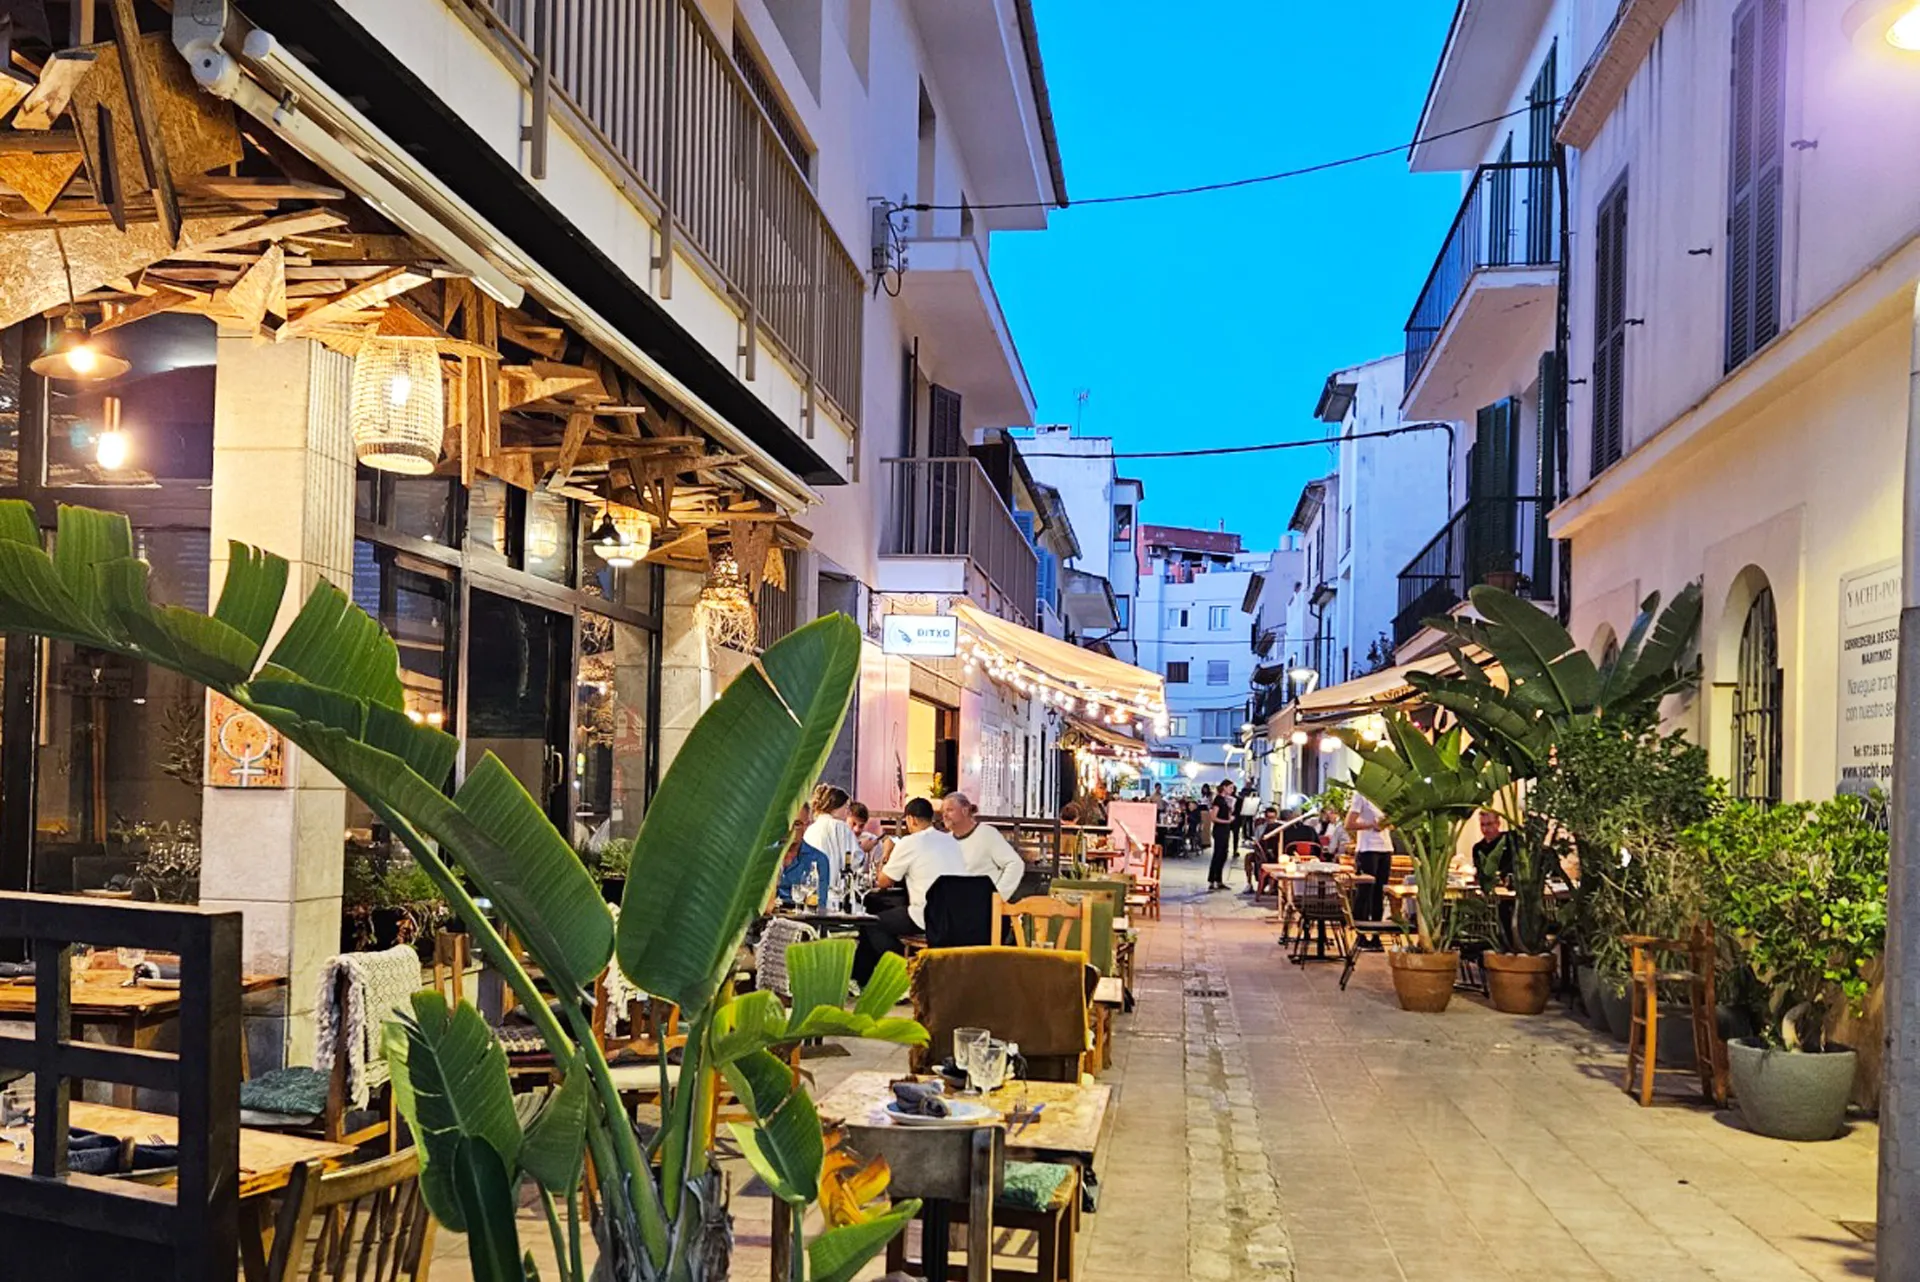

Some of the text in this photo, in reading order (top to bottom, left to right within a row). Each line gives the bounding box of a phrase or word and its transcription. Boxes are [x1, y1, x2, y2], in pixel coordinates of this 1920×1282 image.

[917, 629, 950, 638] DITXO
[1847, 678, 1876, 698] Navegue
[1846, 704, 1858, 721] con
[1859, 701, 1884, 719] nuestro
